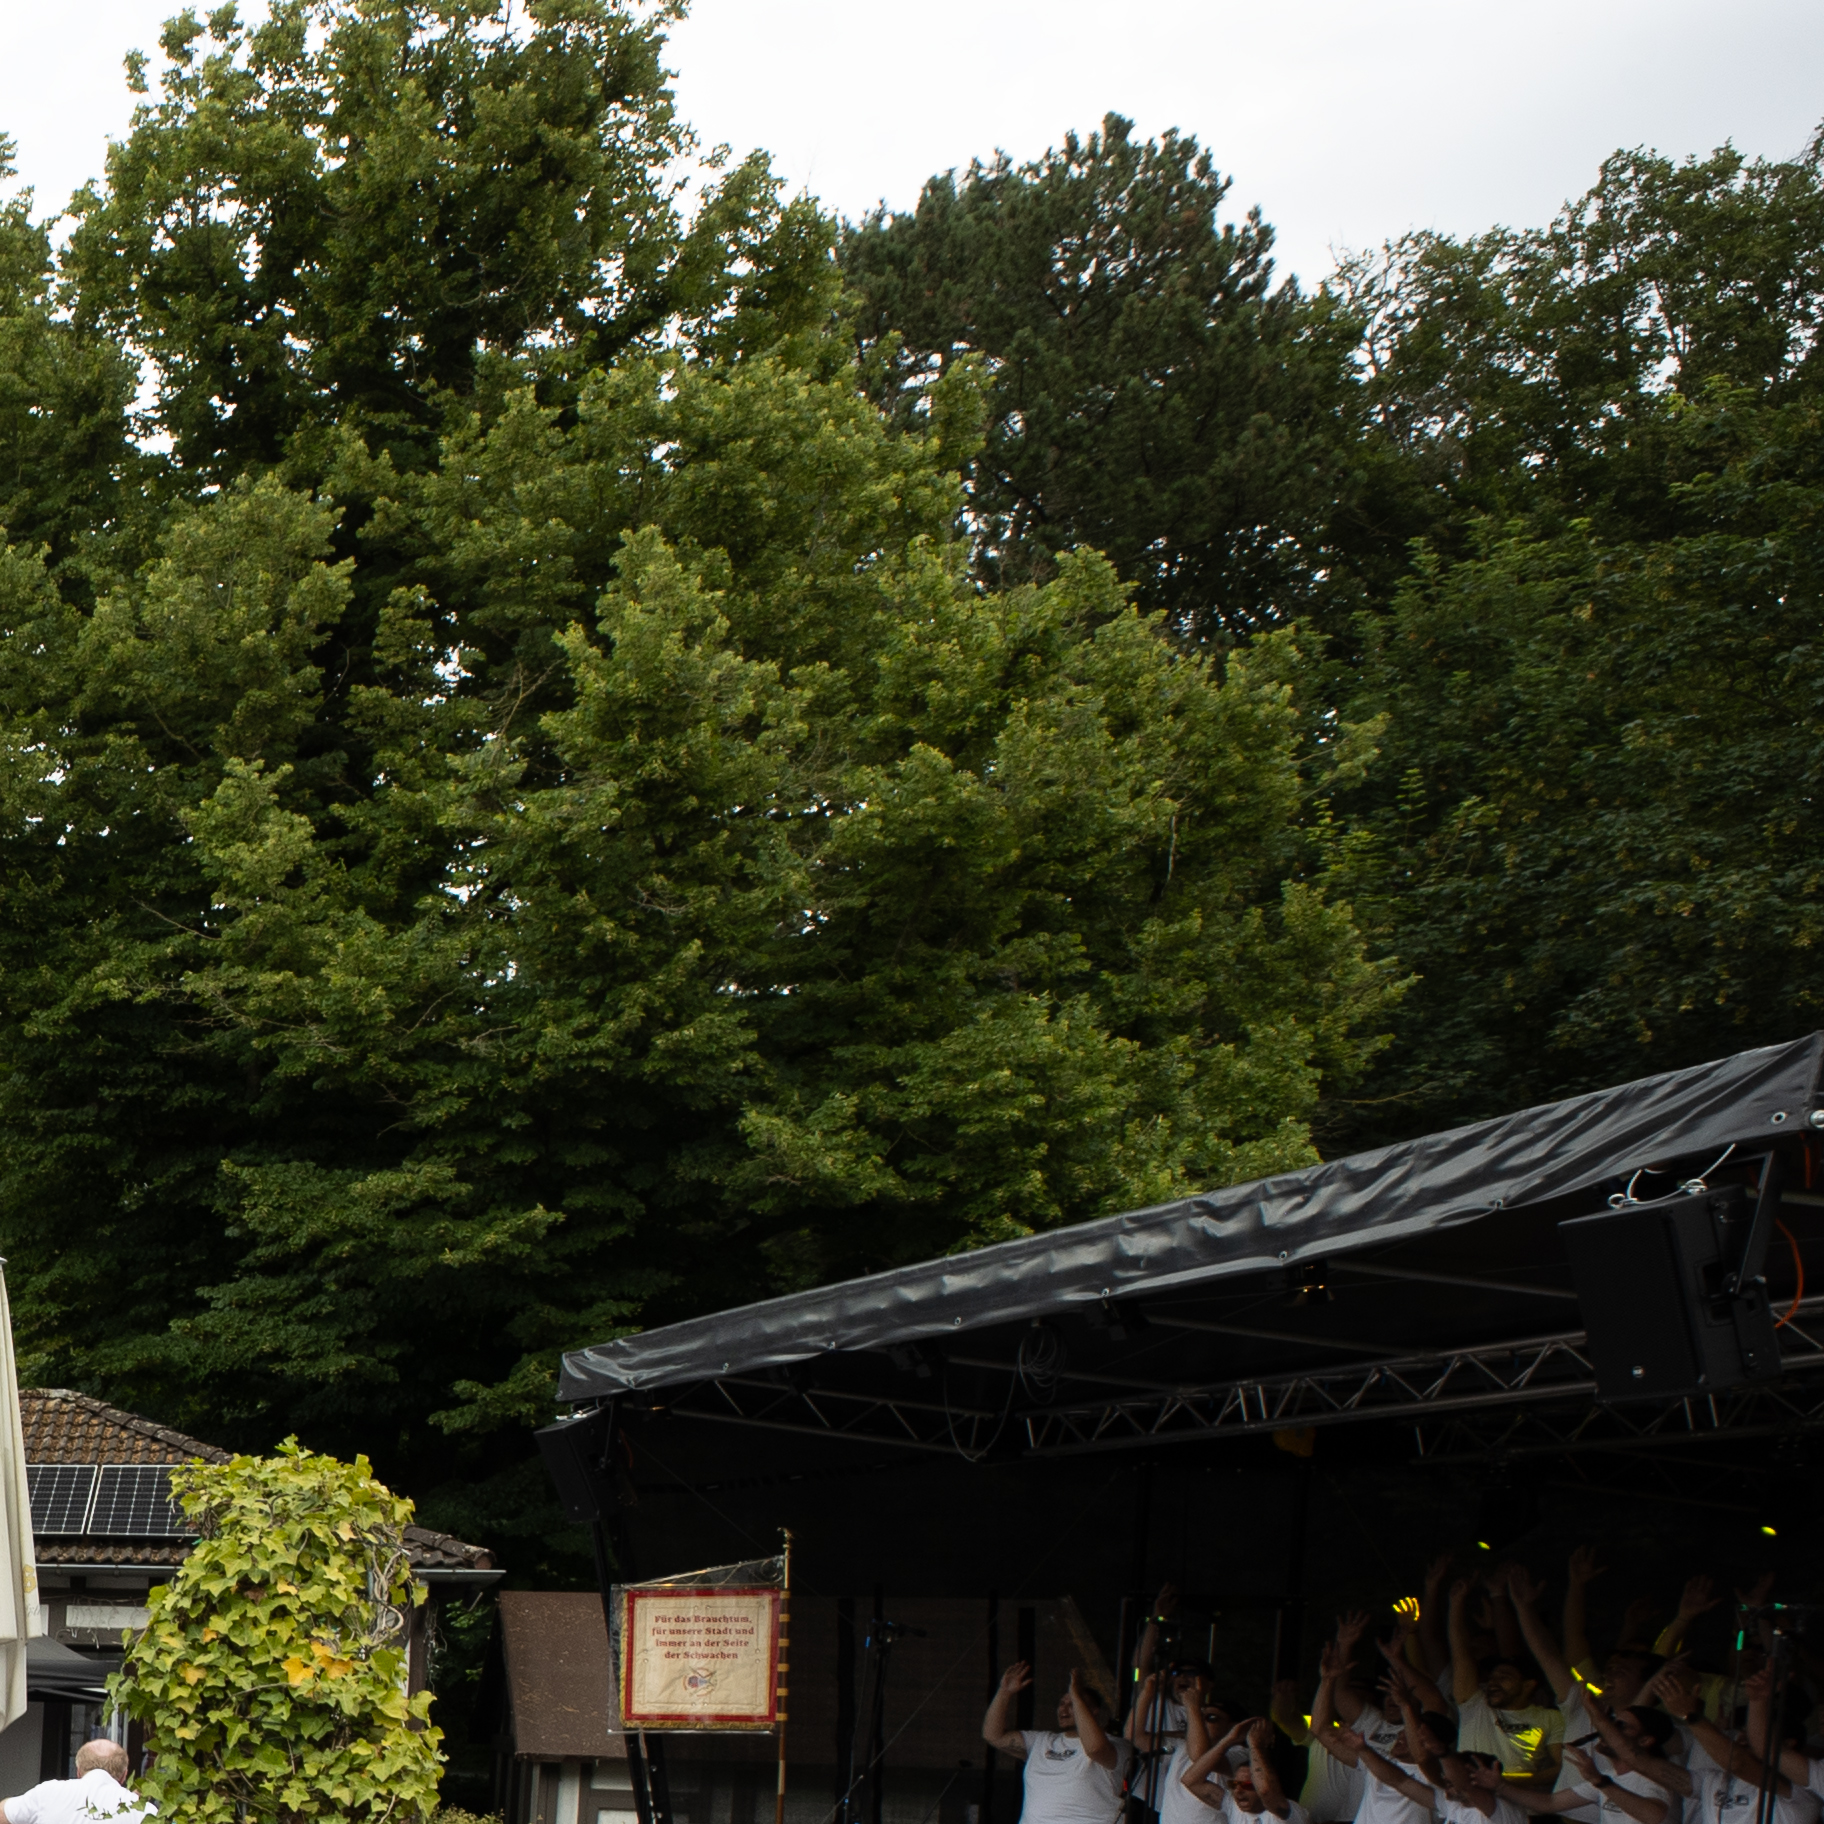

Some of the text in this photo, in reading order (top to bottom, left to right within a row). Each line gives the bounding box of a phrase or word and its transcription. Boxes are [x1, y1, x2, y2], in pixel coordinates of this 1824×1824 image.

[655, 1615, 752, 1624] Für das Brauchtum,
[652, 1627, 666, 1636] für
[705, 1627, 732, 1635] Stadt
[735, 1627, 754, 1635] und
[704, 1639, 720, 1647] der
[723, 1639, 749, 1647] Seite
[664, 1650, 738, 1660] der Schwachen
